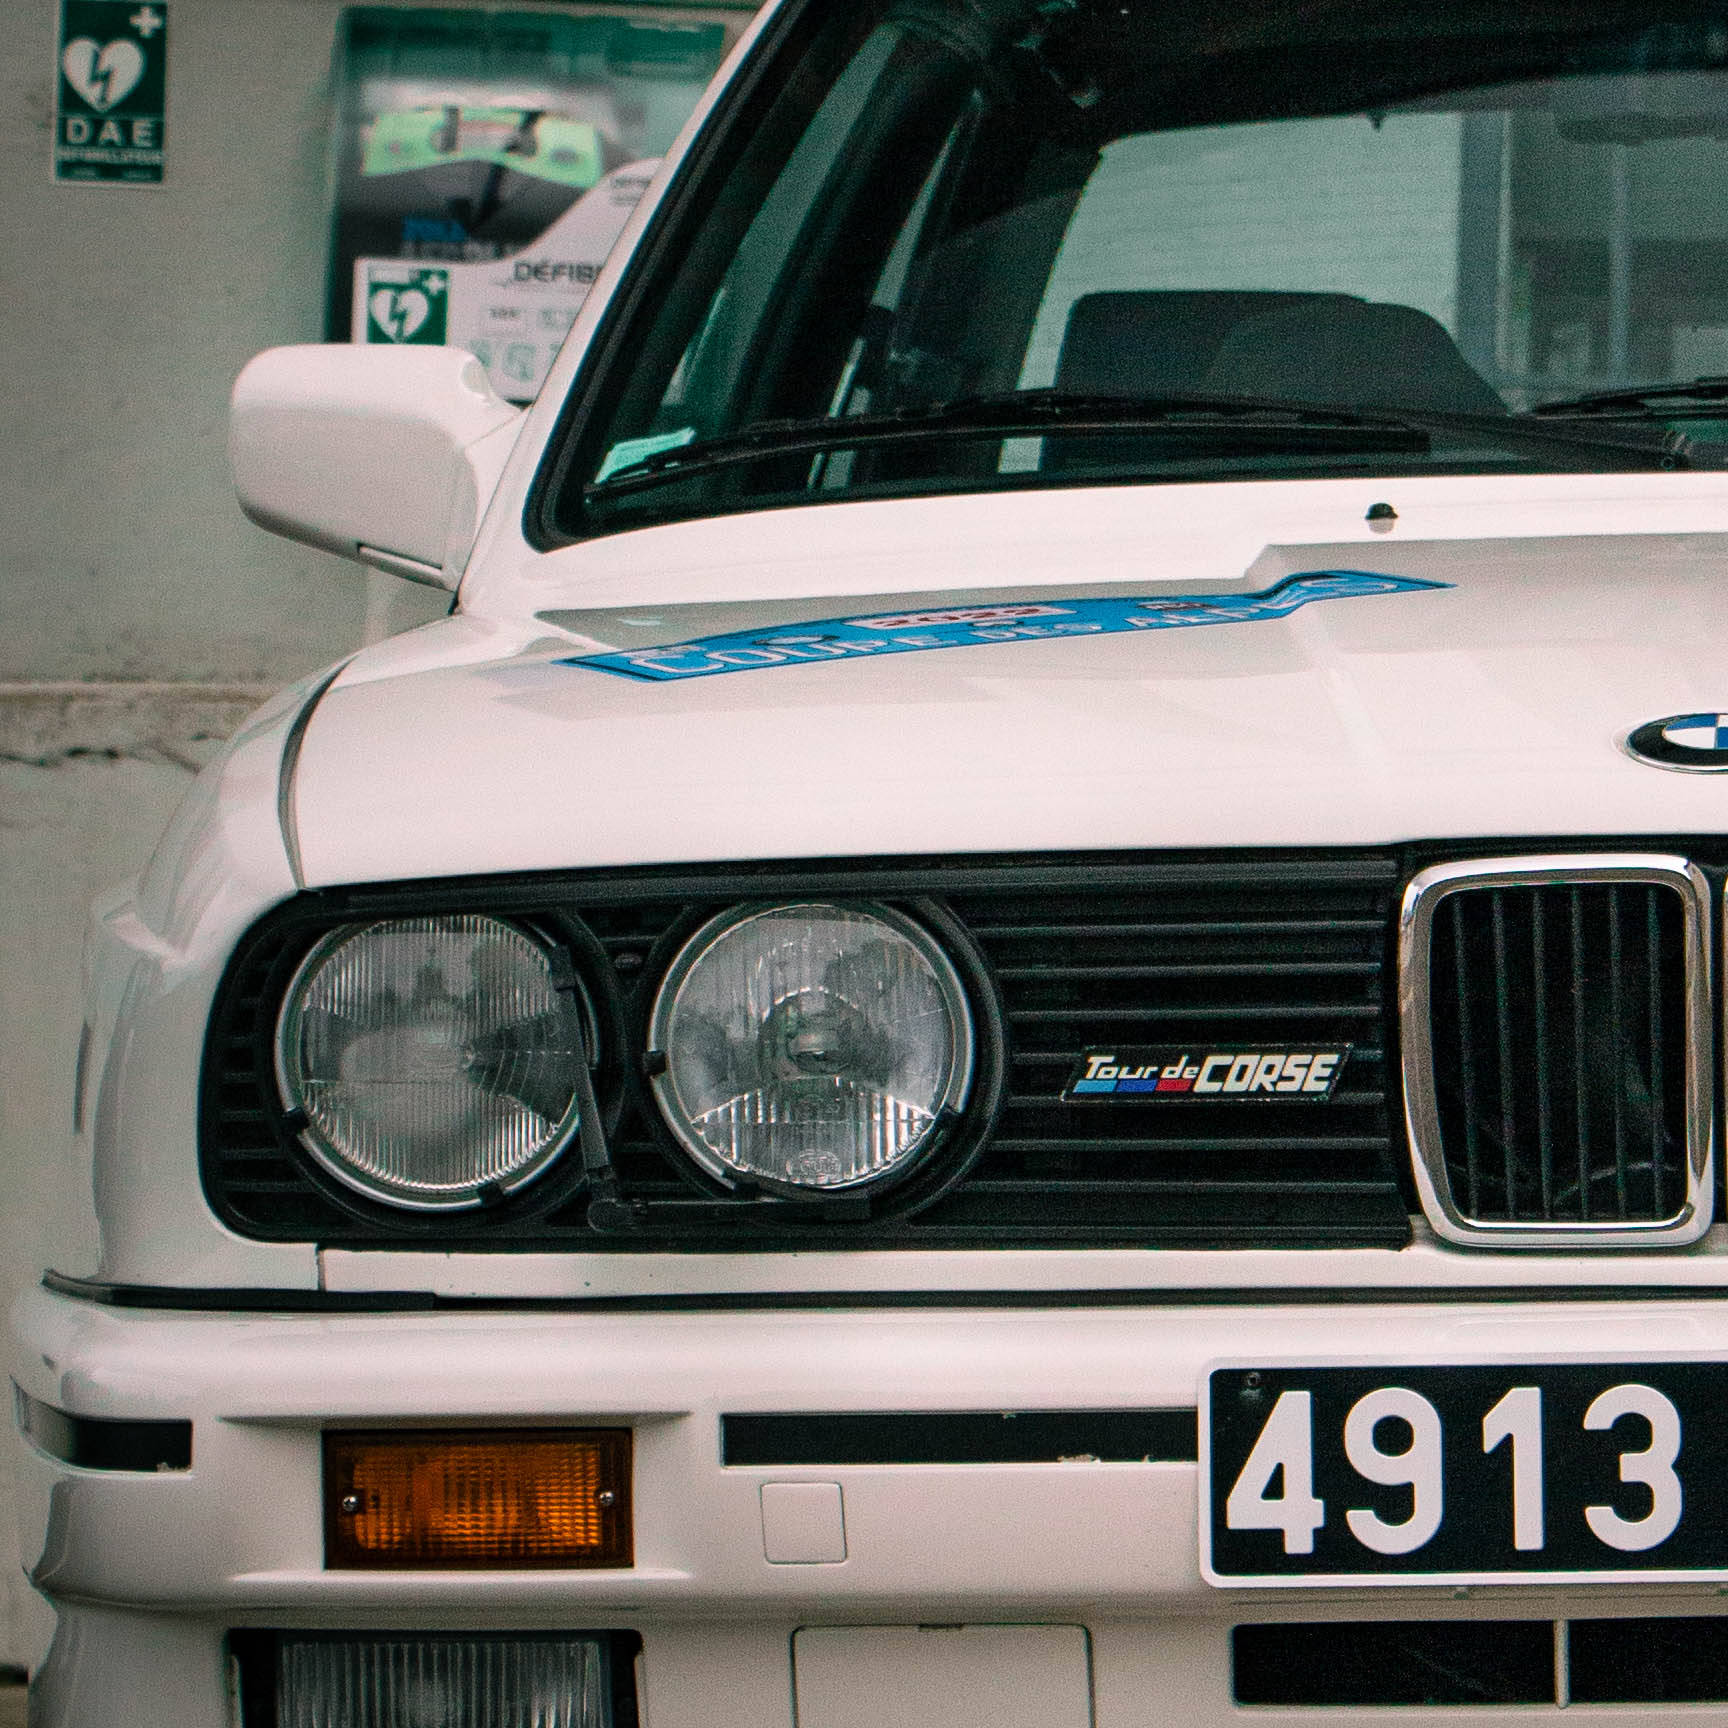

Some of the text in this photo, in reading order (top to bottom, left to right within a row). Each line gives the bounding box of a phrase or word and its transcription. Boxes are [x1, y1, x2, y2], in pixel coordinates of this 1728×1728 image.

[66, 118, 153, 147] DAE
[627, 634, 959, 675] COUPE
[978, 624, 1104, 640] DES
[1086, 1054, 1339, 1092] Tour de CORSE
[1226, 1382, 1683, 1557] 4913
